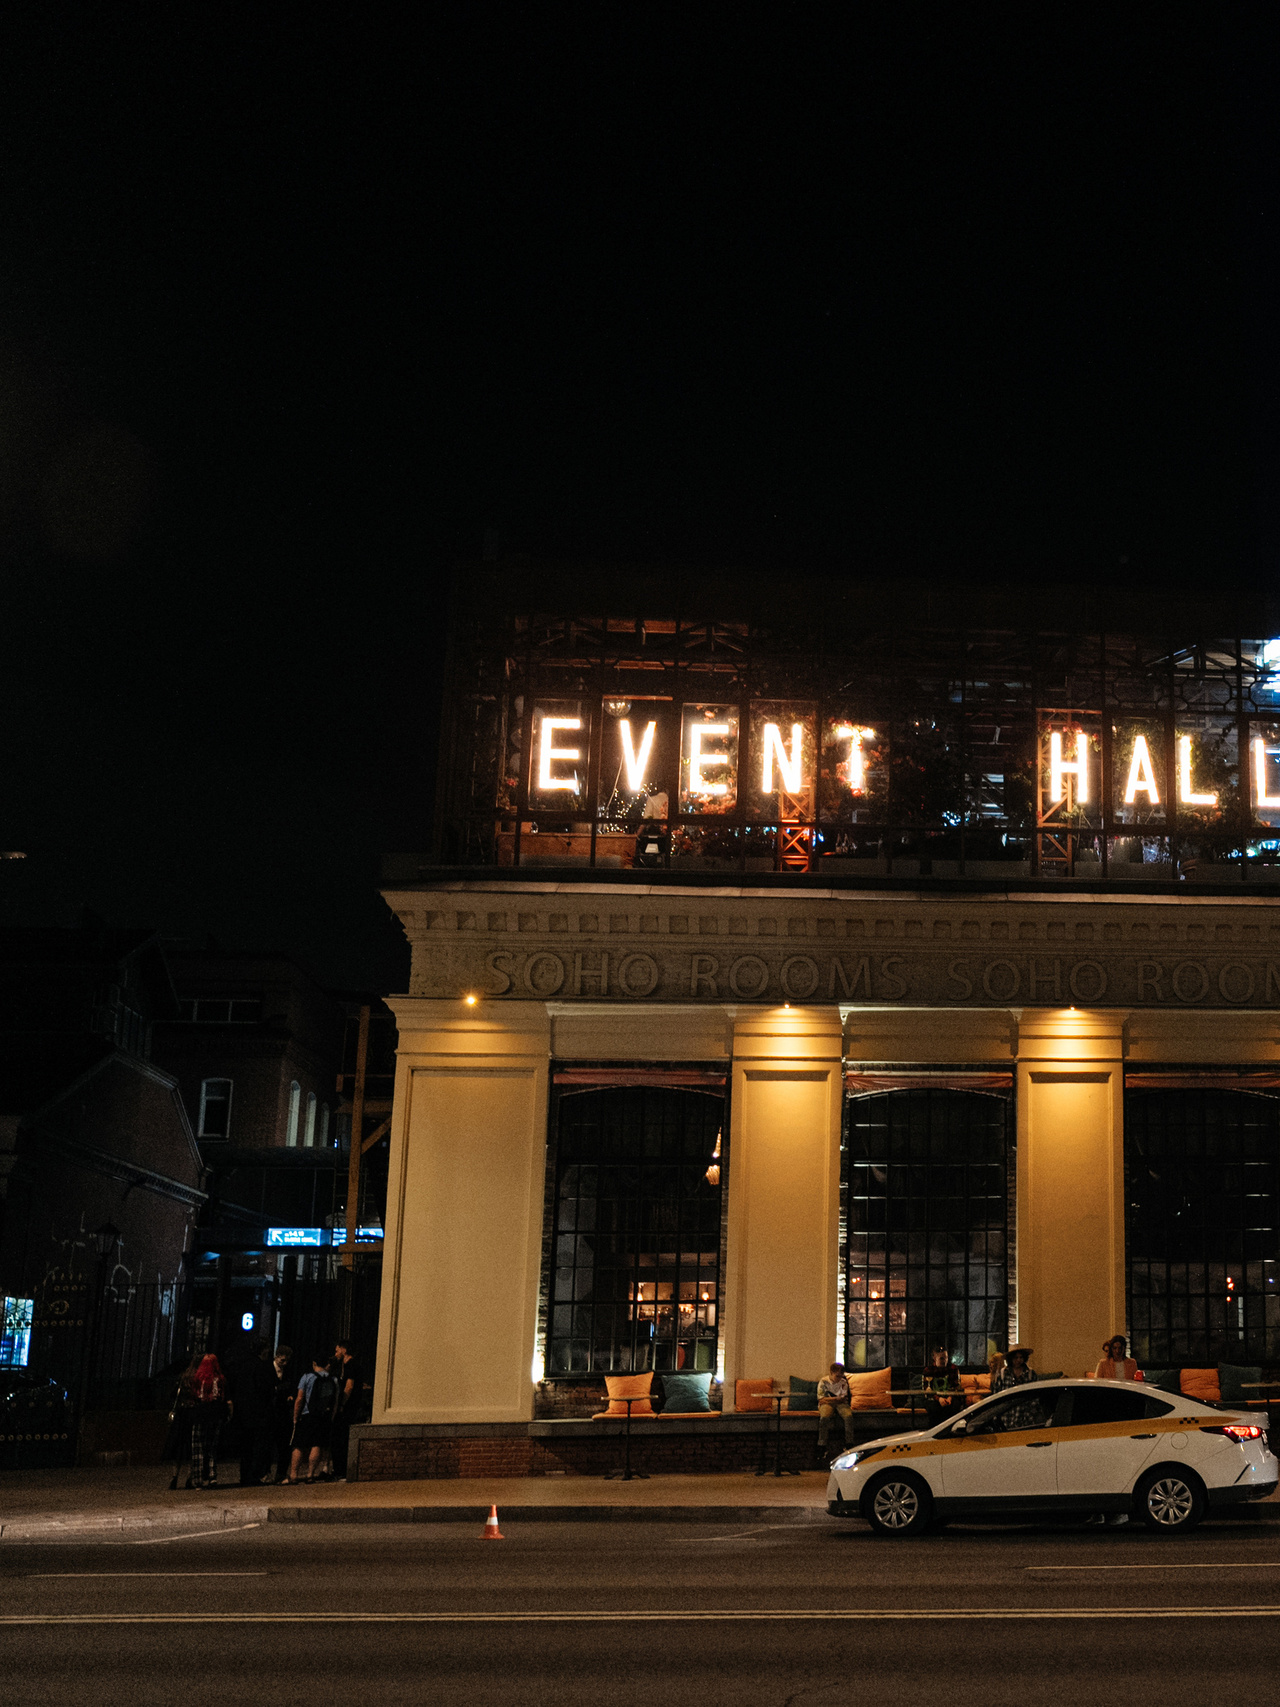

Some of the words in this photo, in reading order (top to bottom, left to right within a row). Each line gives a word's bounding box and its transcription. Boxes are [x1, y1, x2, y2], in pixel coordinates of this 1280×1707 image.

[538, 717, 877, 795] EVENT
[484, 950, 660, 997] SOHO
[690, 953, 907, 1000] ROOMS
[946, 957, 1107, 1001] SOHO
[241, 1312, 254, 1331] 6
